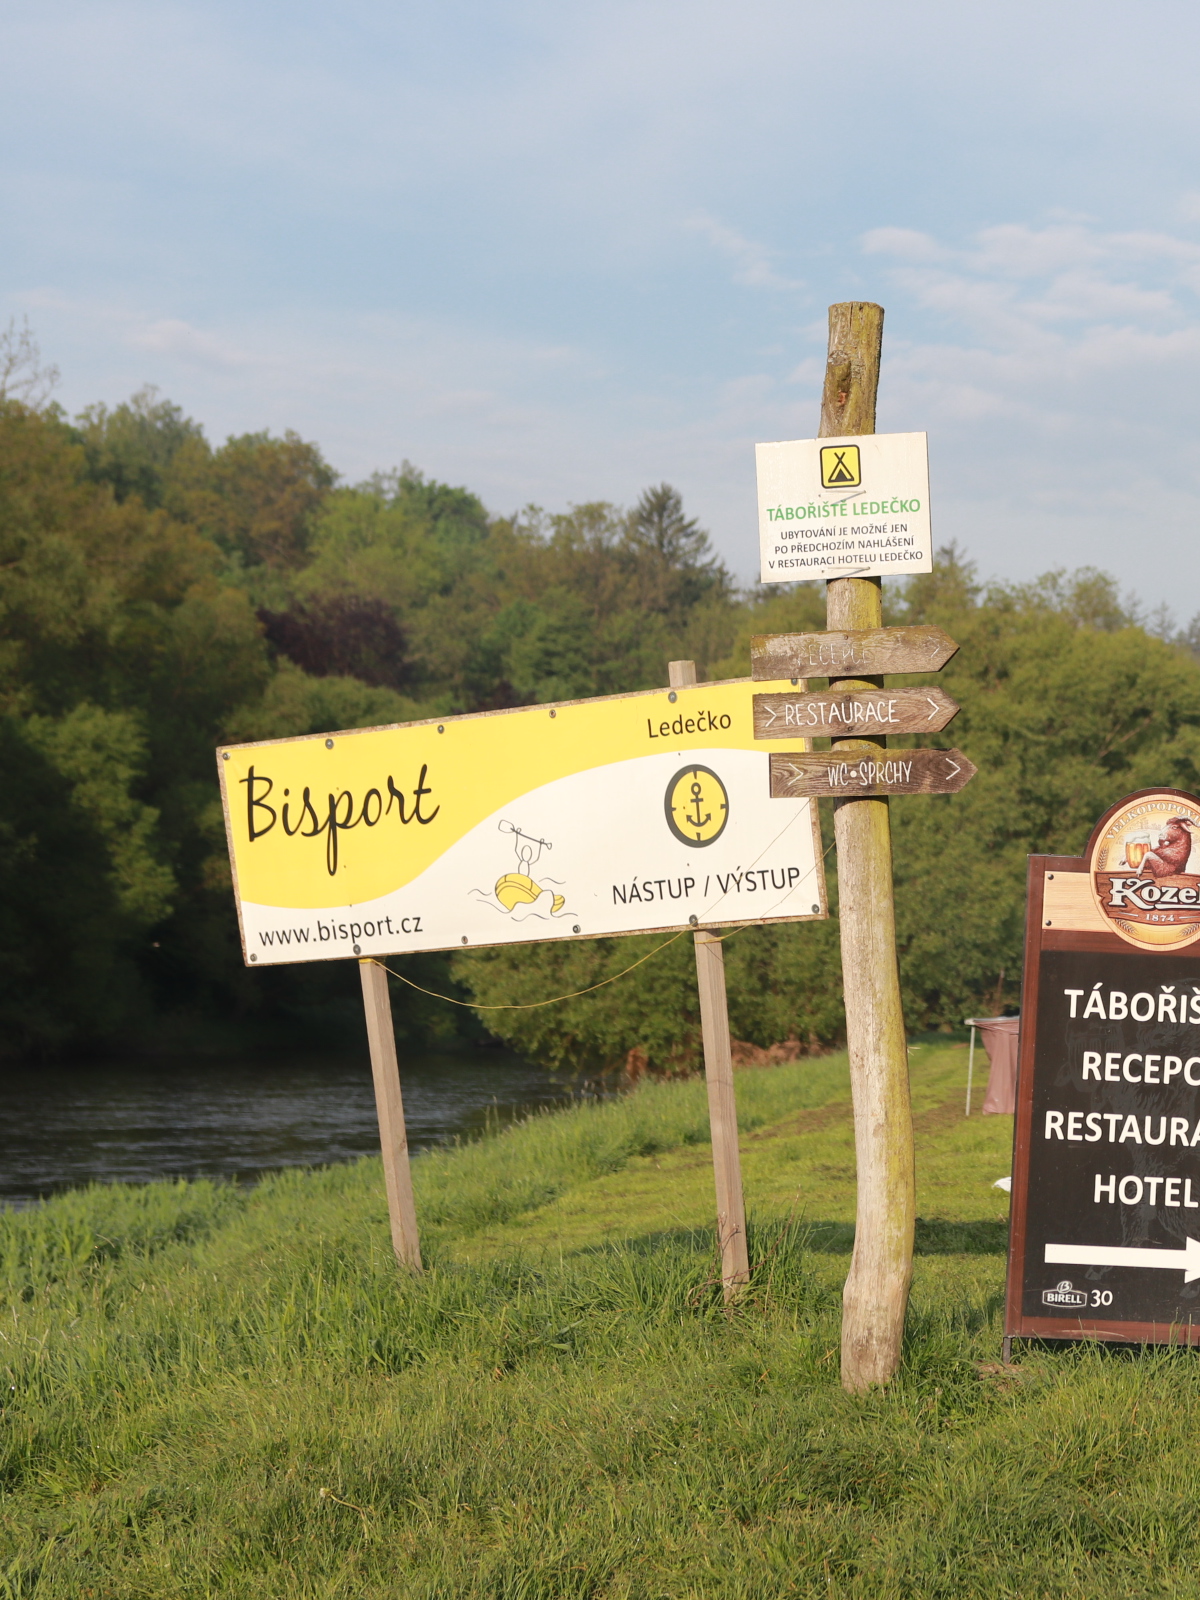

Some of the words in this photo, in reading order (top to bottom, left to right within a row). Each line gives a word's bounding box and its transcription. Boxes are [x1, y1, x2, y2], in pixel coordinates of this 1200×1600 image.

[852, 497, 921, 516] LEDEČKO
[780, 526, 836, 540] UBYTOVÁNÍ
[838, 526, 848, 536] JE
[851, 523, 888, 535] MOŽNÉ
[890, 523, 908, 532] JEN
[774, 545, 788, 555] PO
[791, 538, 855, 553] PŘEDCHOZÍM
[858, 535, 914, 549] NAHLÁŠENÍ
[768, 560, 775, 569] V
[778, 556, 835, 569] RESTAURACI
[838, 554, 876, 565] HOTELU
[880, 549, 923, 562] LEDEČKO
[648, 710, 731, 738] Ledečko
[785, 700, 900, 726] RESTAURACE
[238, 763, 441, 876] Bisport
[612, 876, 695, 905] NÁSTUP
[716, 865, 800, 894] VÝSTUP
[1145, 913, 1175, 922] 1874
[259, 915, 423, 947] www.bisport.cz
[1093, 1173, 1199, 1208] HOTEL
[1047, 1293, 1082, 1304] BIRELL
[1090, 1289, 1113, 1308] 30
